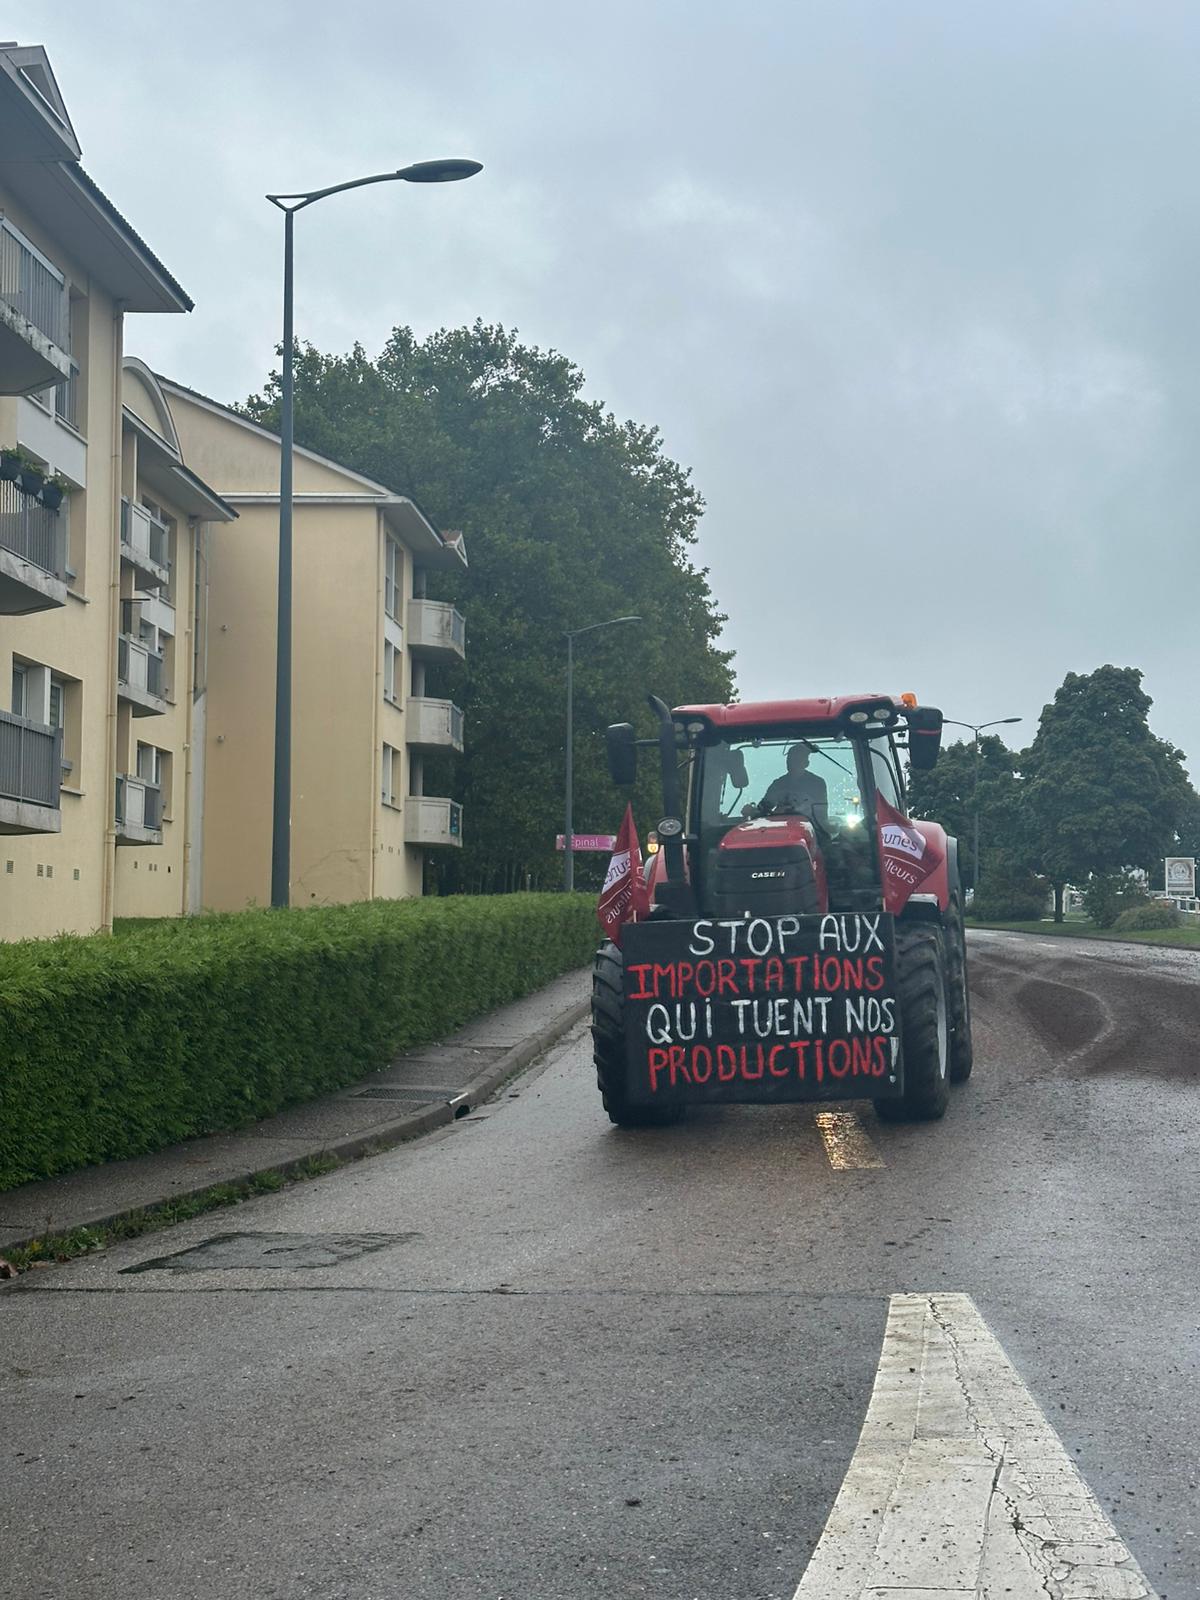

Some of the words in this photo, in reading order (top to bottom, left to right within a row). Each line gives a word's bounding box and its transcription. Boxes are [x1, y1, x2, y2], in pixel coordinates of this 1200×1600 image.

[571, 835, 598, 848] pinal
[880, 833, 919, 851] unes
[751, 871, 776, 879] CASE
[689, 916, 801, 956] STOP
[819, 914, 885, 953] AUX
[730, 997, 833, 1038] TUENT
[845, 996, 896, 1034] NOS
